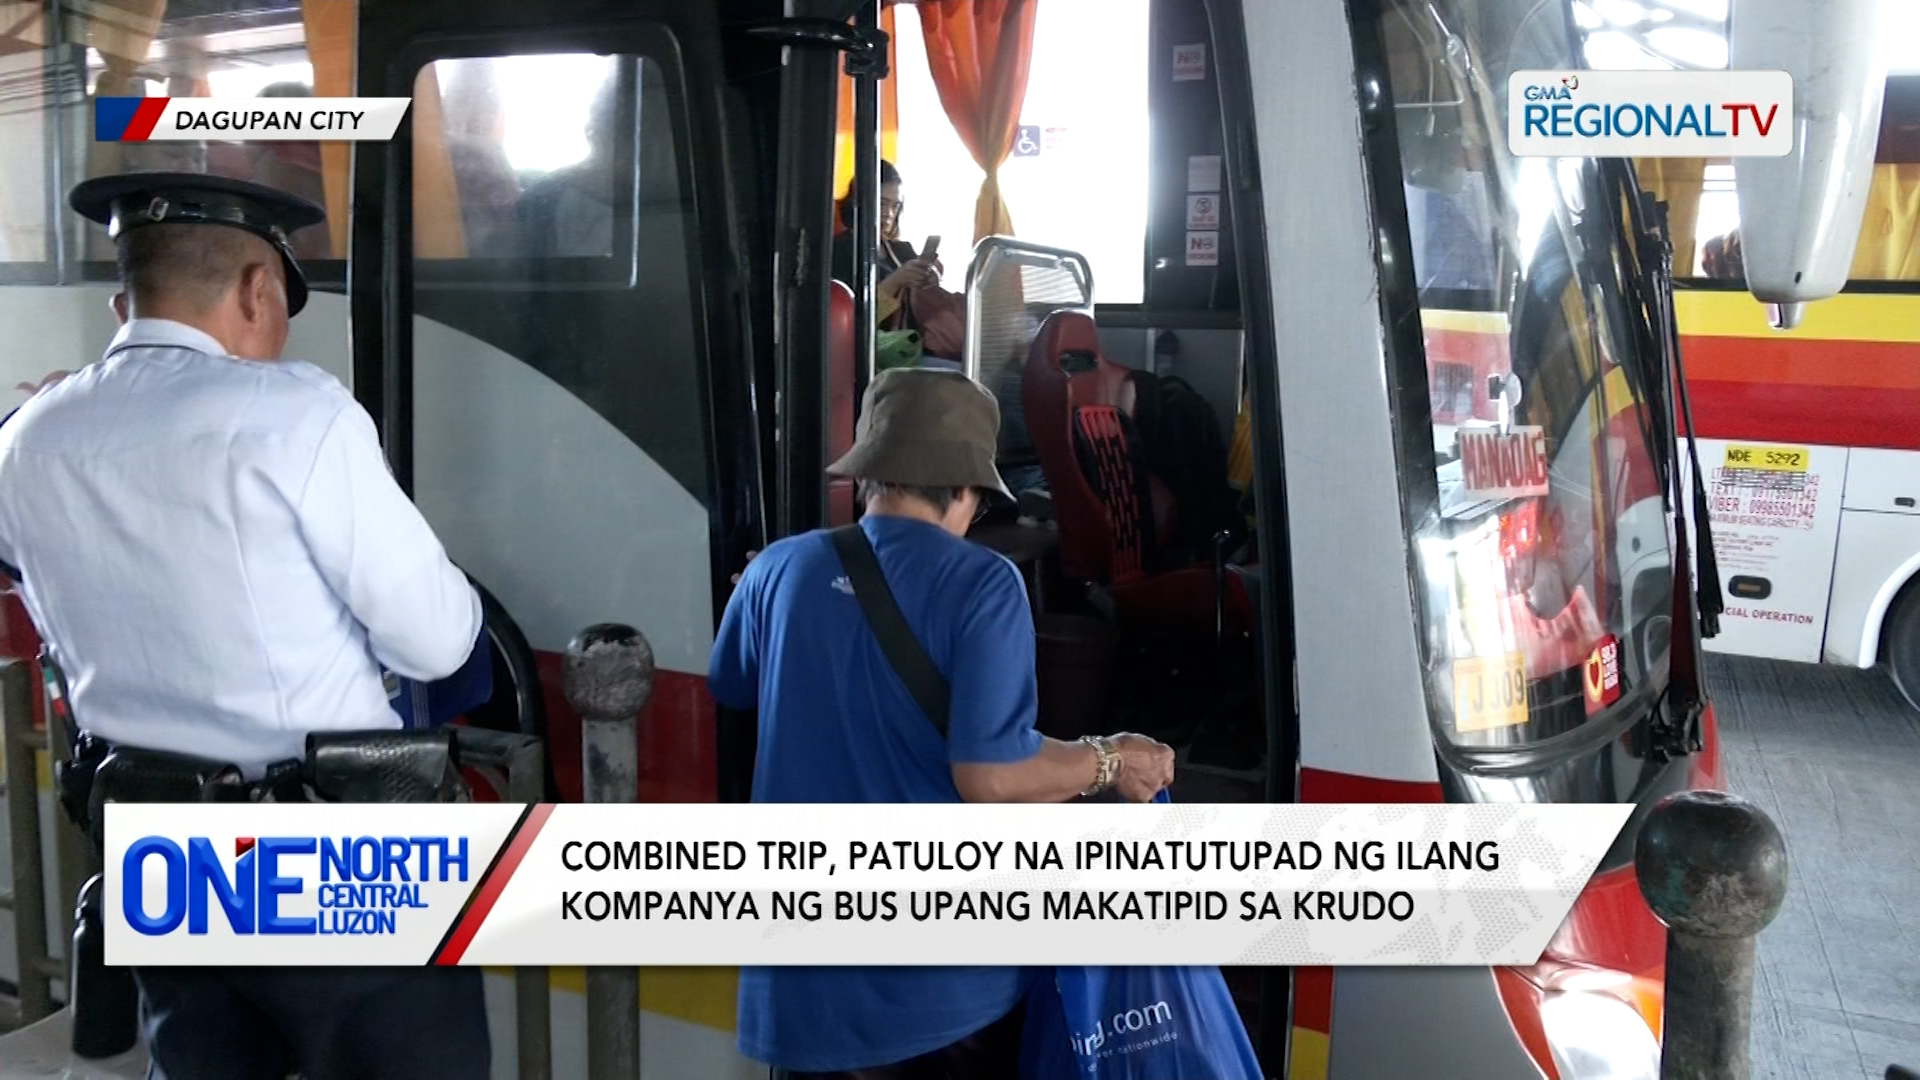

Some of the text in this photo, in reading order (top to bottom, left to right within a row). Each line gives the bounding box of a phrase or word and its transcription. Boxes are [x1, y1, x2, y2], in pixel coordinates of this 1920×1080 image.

[1727, 448, 1801, 467] NDE 5292
[1752, 609, 1814, 624] OPERATION
